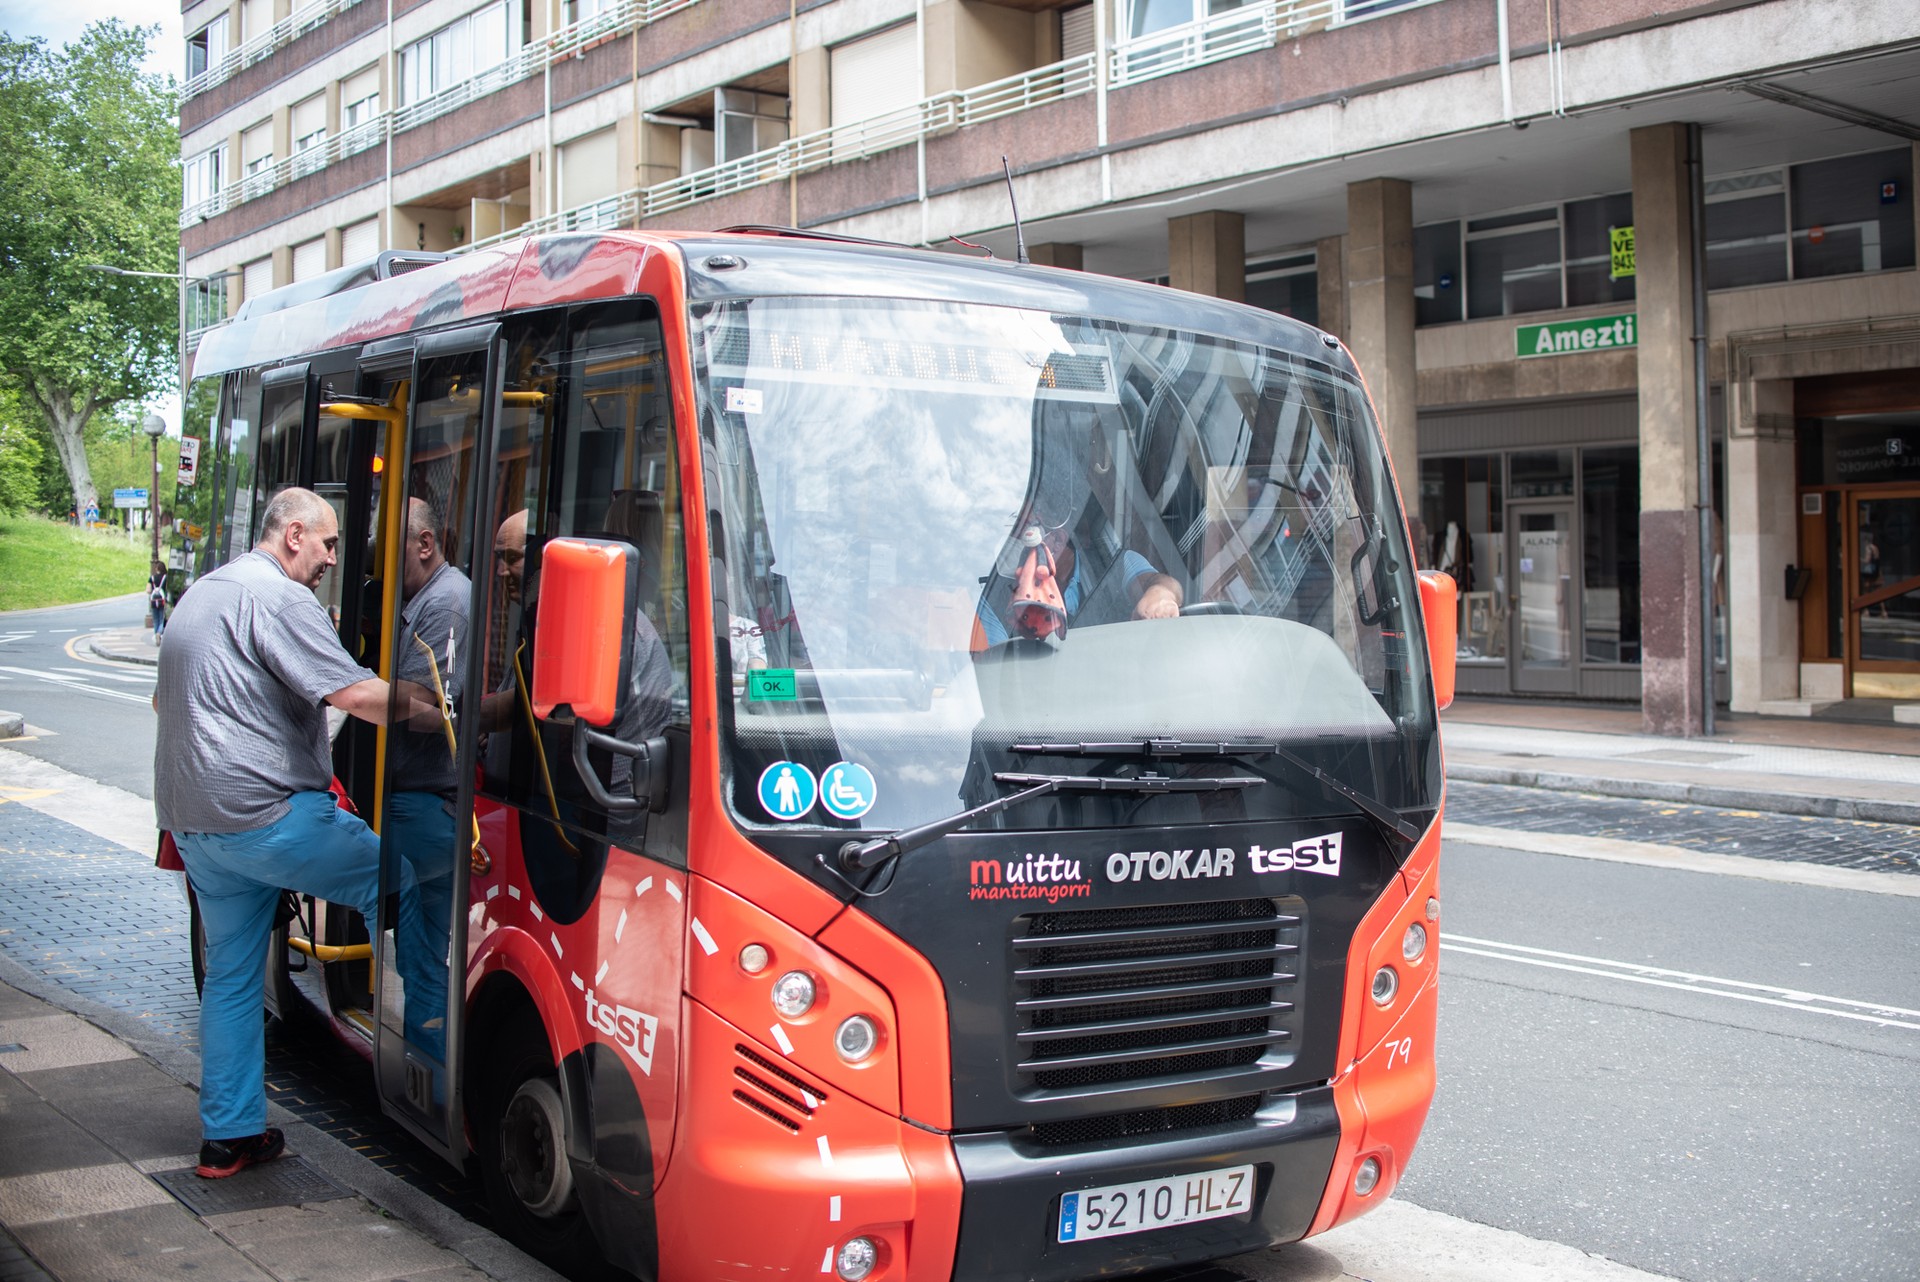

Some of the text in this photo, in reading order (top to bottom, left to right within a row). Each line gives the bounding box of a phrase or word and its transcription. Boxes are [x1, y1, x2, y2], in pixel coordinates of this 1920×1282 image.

[1535, 315, 1634, 354] Amezti
[1106, 848, 1236, 883] OTOKAR
[1248, 838, 1338, 874] tsst
[969, 878, 1092, 904] manttangorri
[585, 988, 651, 1059] tsst
[1385, 1036, 1412, 1070] 79
[1086, 1172, 1245, 1231] 5210 HLZ
[1064, 1222, 1073, 1233] E
